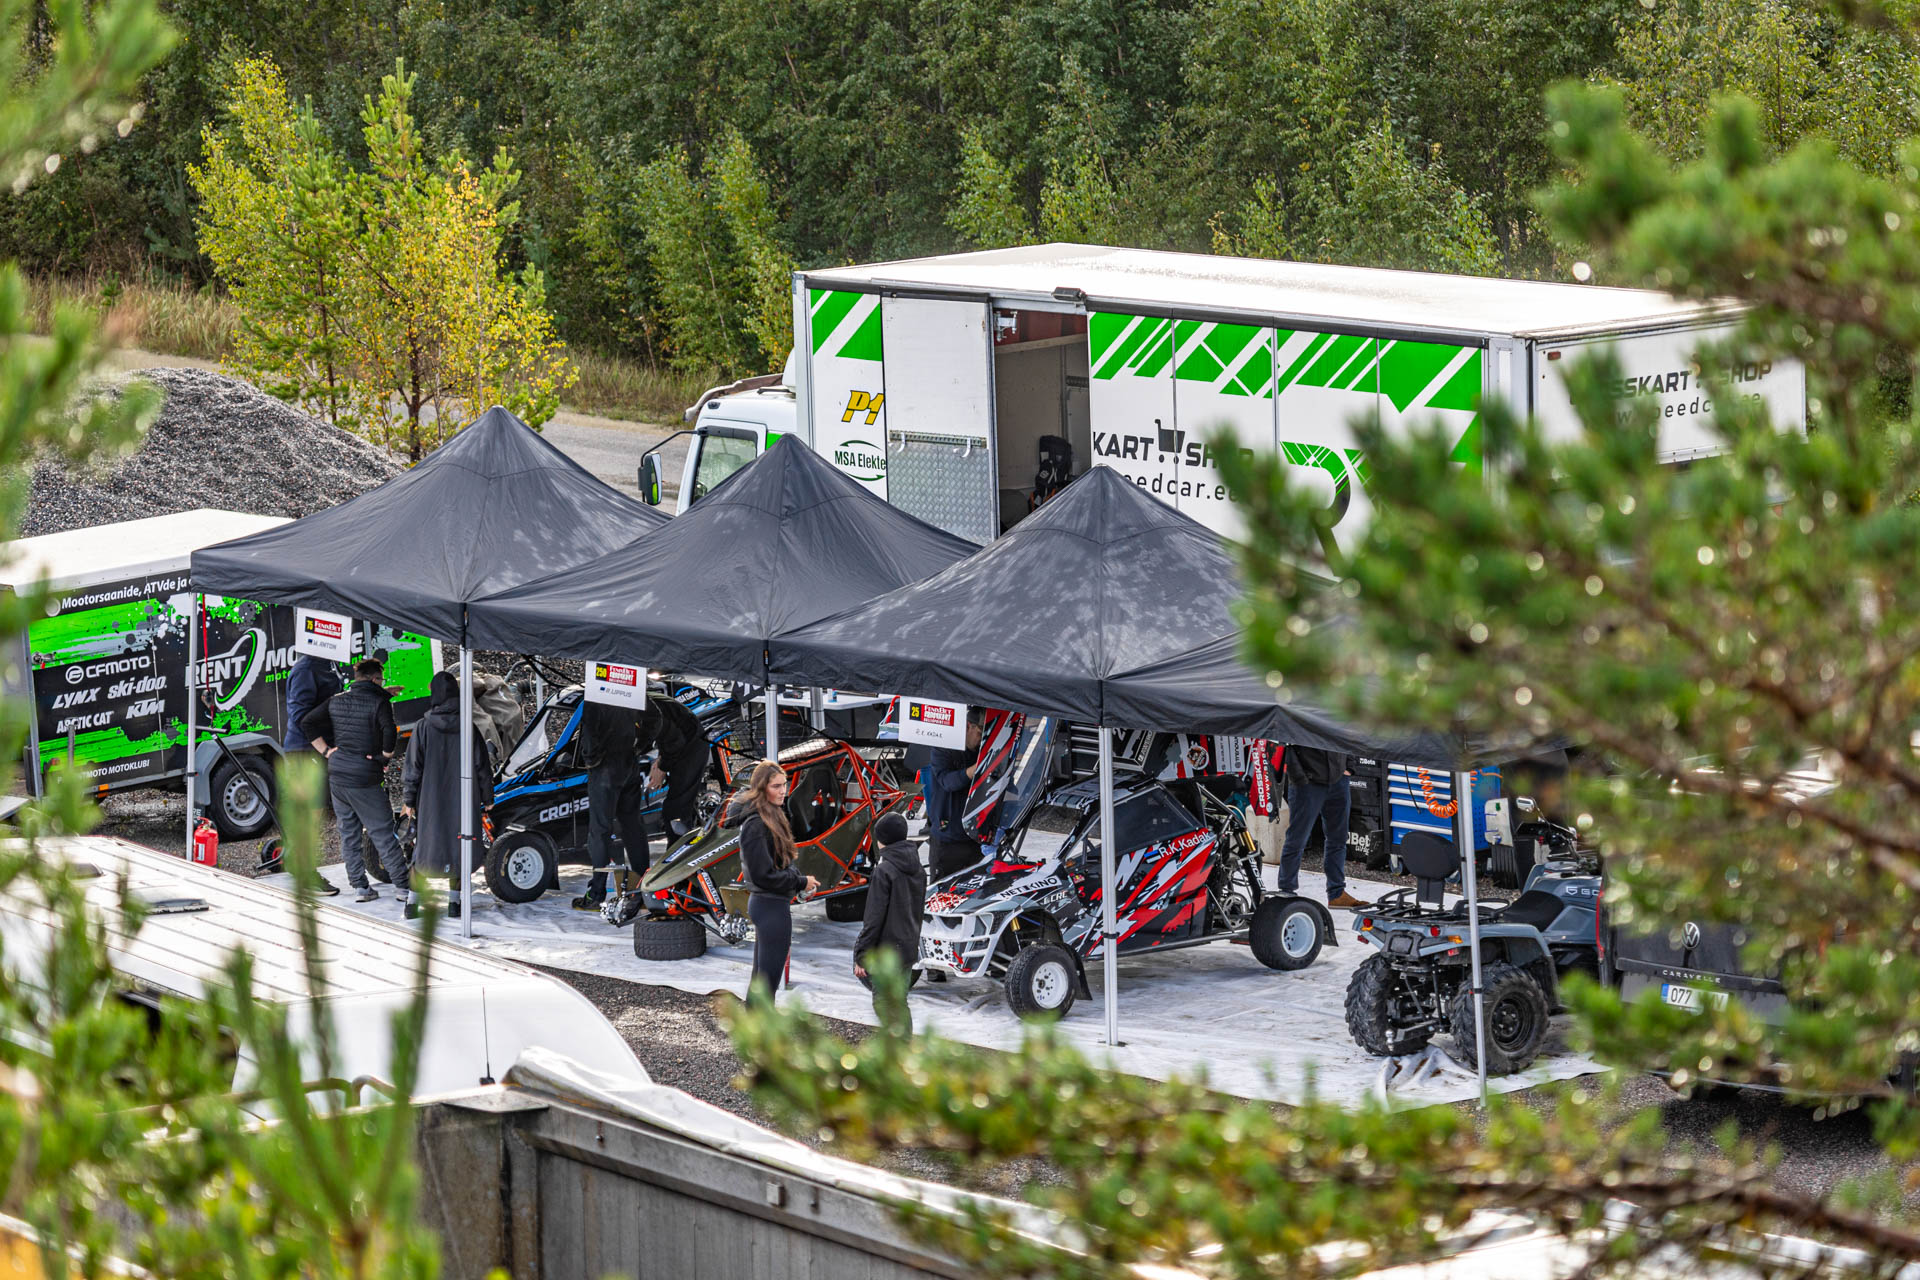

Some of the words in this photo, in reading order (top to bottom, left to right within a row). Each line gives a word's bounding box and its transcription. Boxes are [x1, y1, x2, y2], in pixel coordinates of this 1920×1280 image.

[841, 389, 884, 426] P1
[834, 450, 856, 467] MSA
[61, 584, 142, 609] Mootorsaanide,
[143, 578, 176, 595] ATVde
[176, 577, 187, 591] ja
[86, 655, 151, 678] CFMOTO
[52, 687, 102, 709] LYNX
[107, 675, 166, 699] ski-doo
[56, 715, 92, 734] ARCTIC
[92, 710, 115, 727] CAT
[125, 698, 165, 719] KTM
[911, 706, 920, 718] 25
[108, 759, 151, 774] MOTOKLUBI
[1250, 746, 1266, 808] CROSSKART
[1157, 831, 1212, 858] R.K.Kadak
[1662, 970, 1721, 984] CARAVELLE
